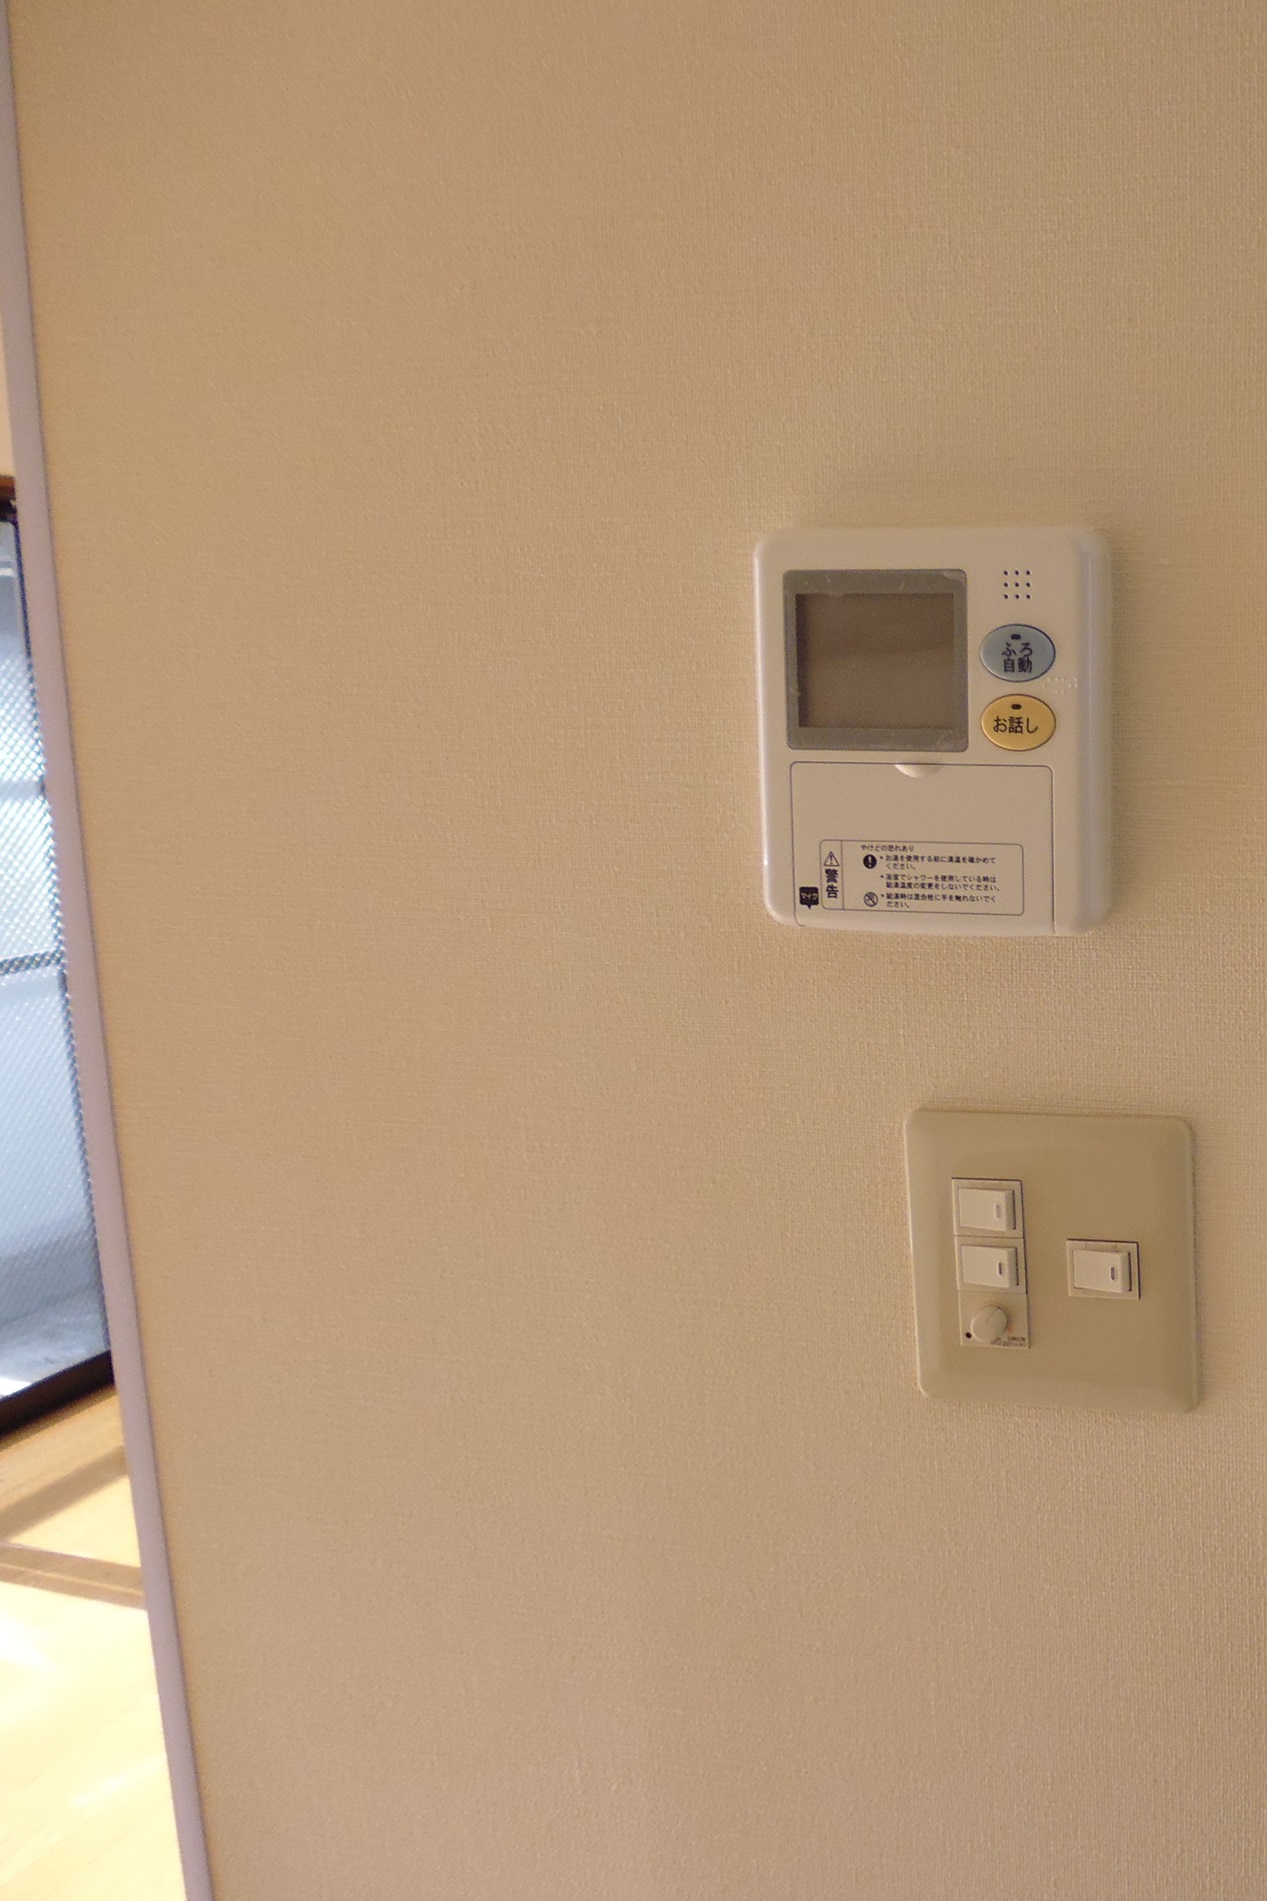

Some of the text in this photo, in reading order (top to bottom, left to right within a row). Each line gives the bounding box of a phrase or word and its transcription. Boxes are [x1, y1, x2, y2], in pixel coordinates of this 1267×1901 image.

[1001, 642, 1033, 656] ふろ
[1003, 657, 1033, 673] 自動
[993, 716, 1039, 734] お話し
[824, 868, 839, 898] 警告
